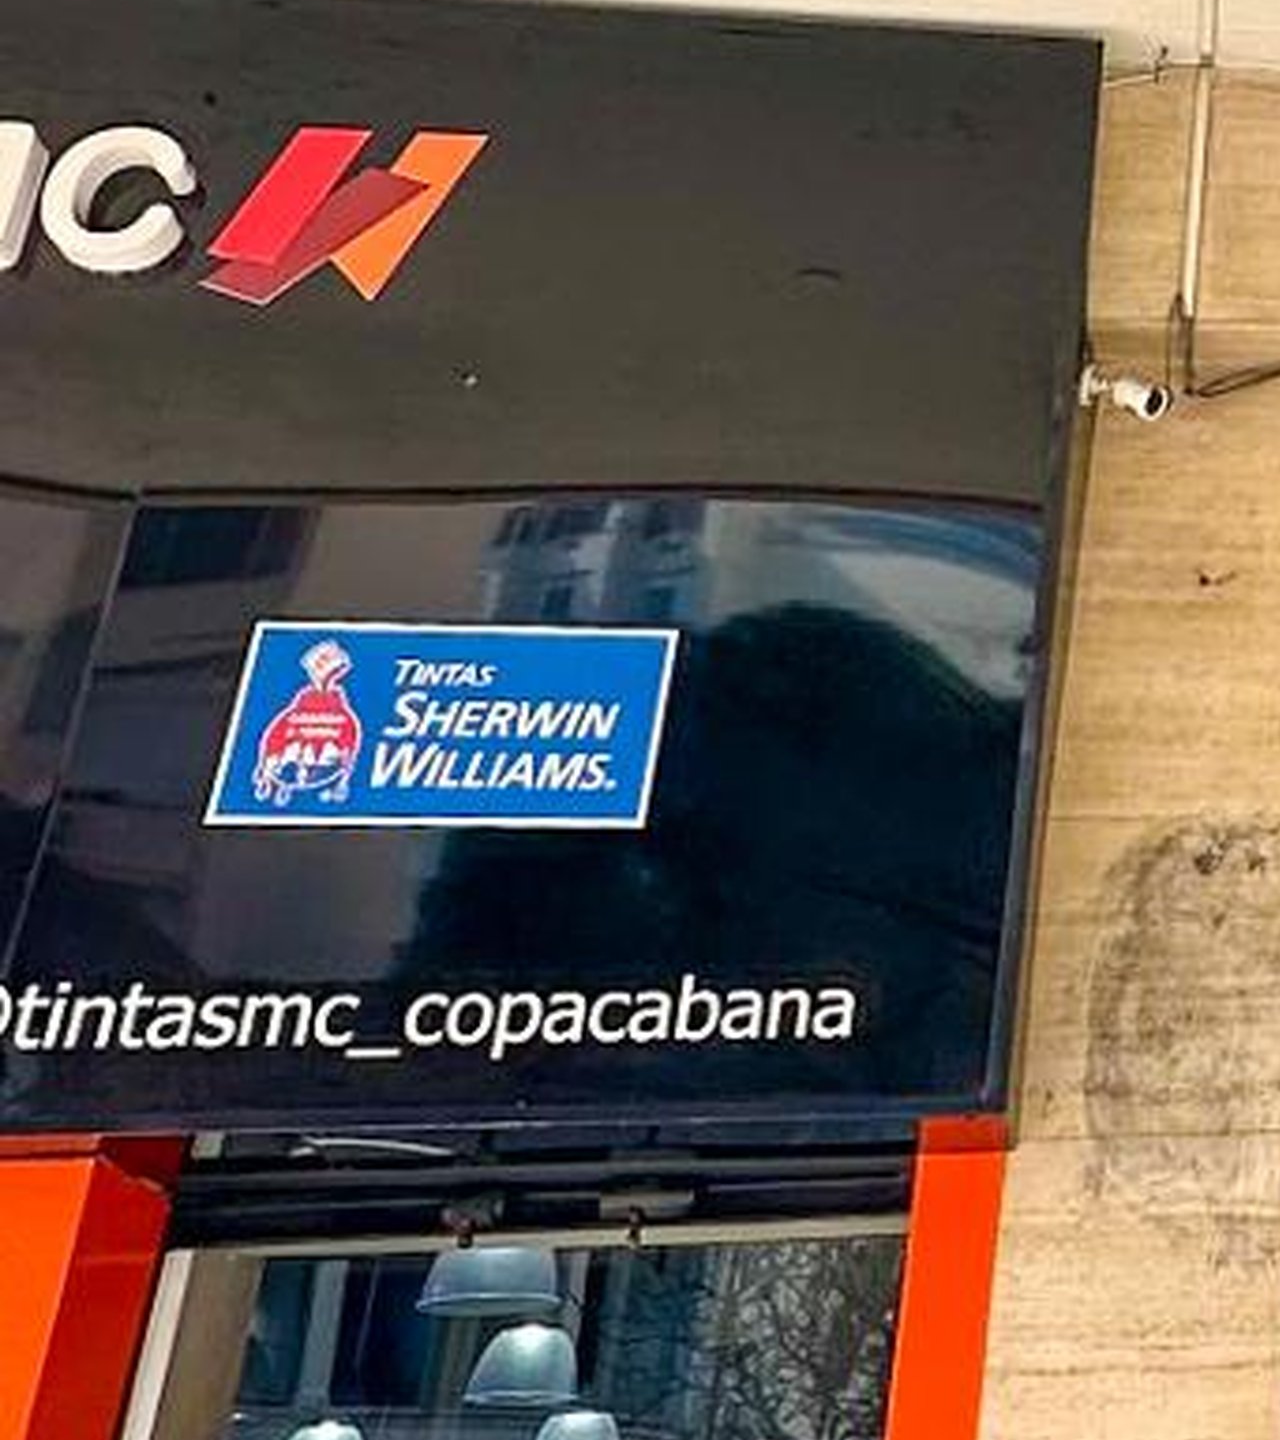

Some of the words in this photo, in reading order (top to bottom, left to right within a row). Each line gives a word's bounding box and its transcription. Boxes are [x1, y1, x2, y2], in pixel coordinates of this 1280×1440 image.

[394, 659, 498, 687] TINTAS
[383, 691, 620, 740] SHERWIN
[0, 974, 856, 1060] tintasmc_copacabana
